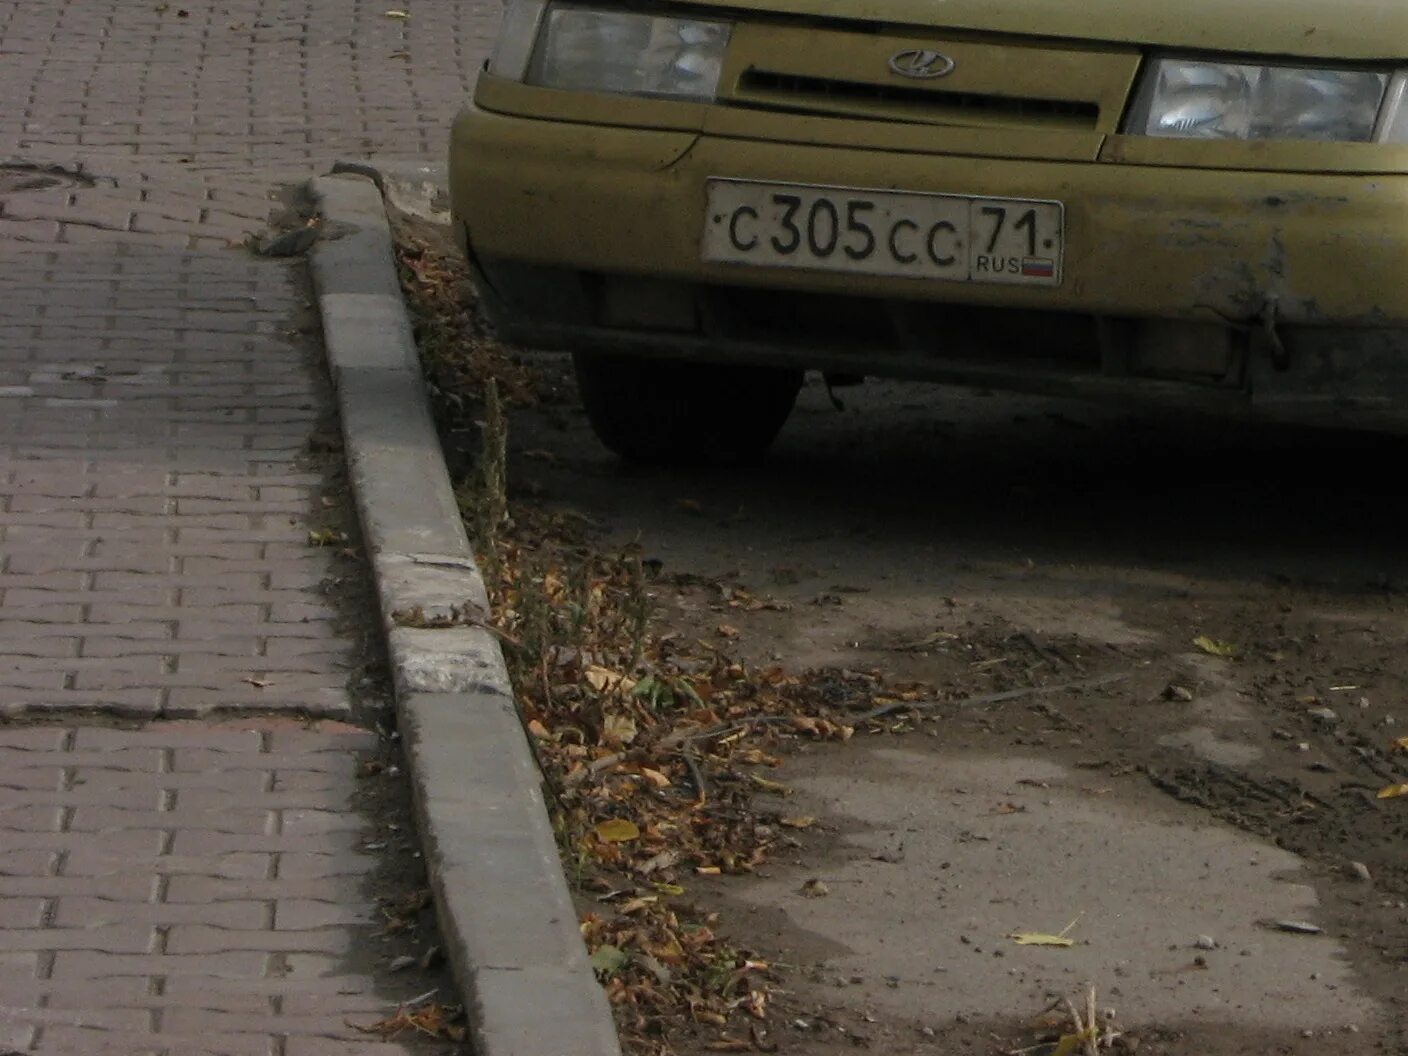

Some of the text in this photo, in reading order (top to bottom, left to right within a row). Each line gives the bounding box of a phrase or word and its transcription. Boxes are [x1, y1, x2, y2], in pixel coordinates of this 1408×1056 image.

[729, 194, 1039, 266] С305СС 71
[977, 255, 1020, 274] RUS
